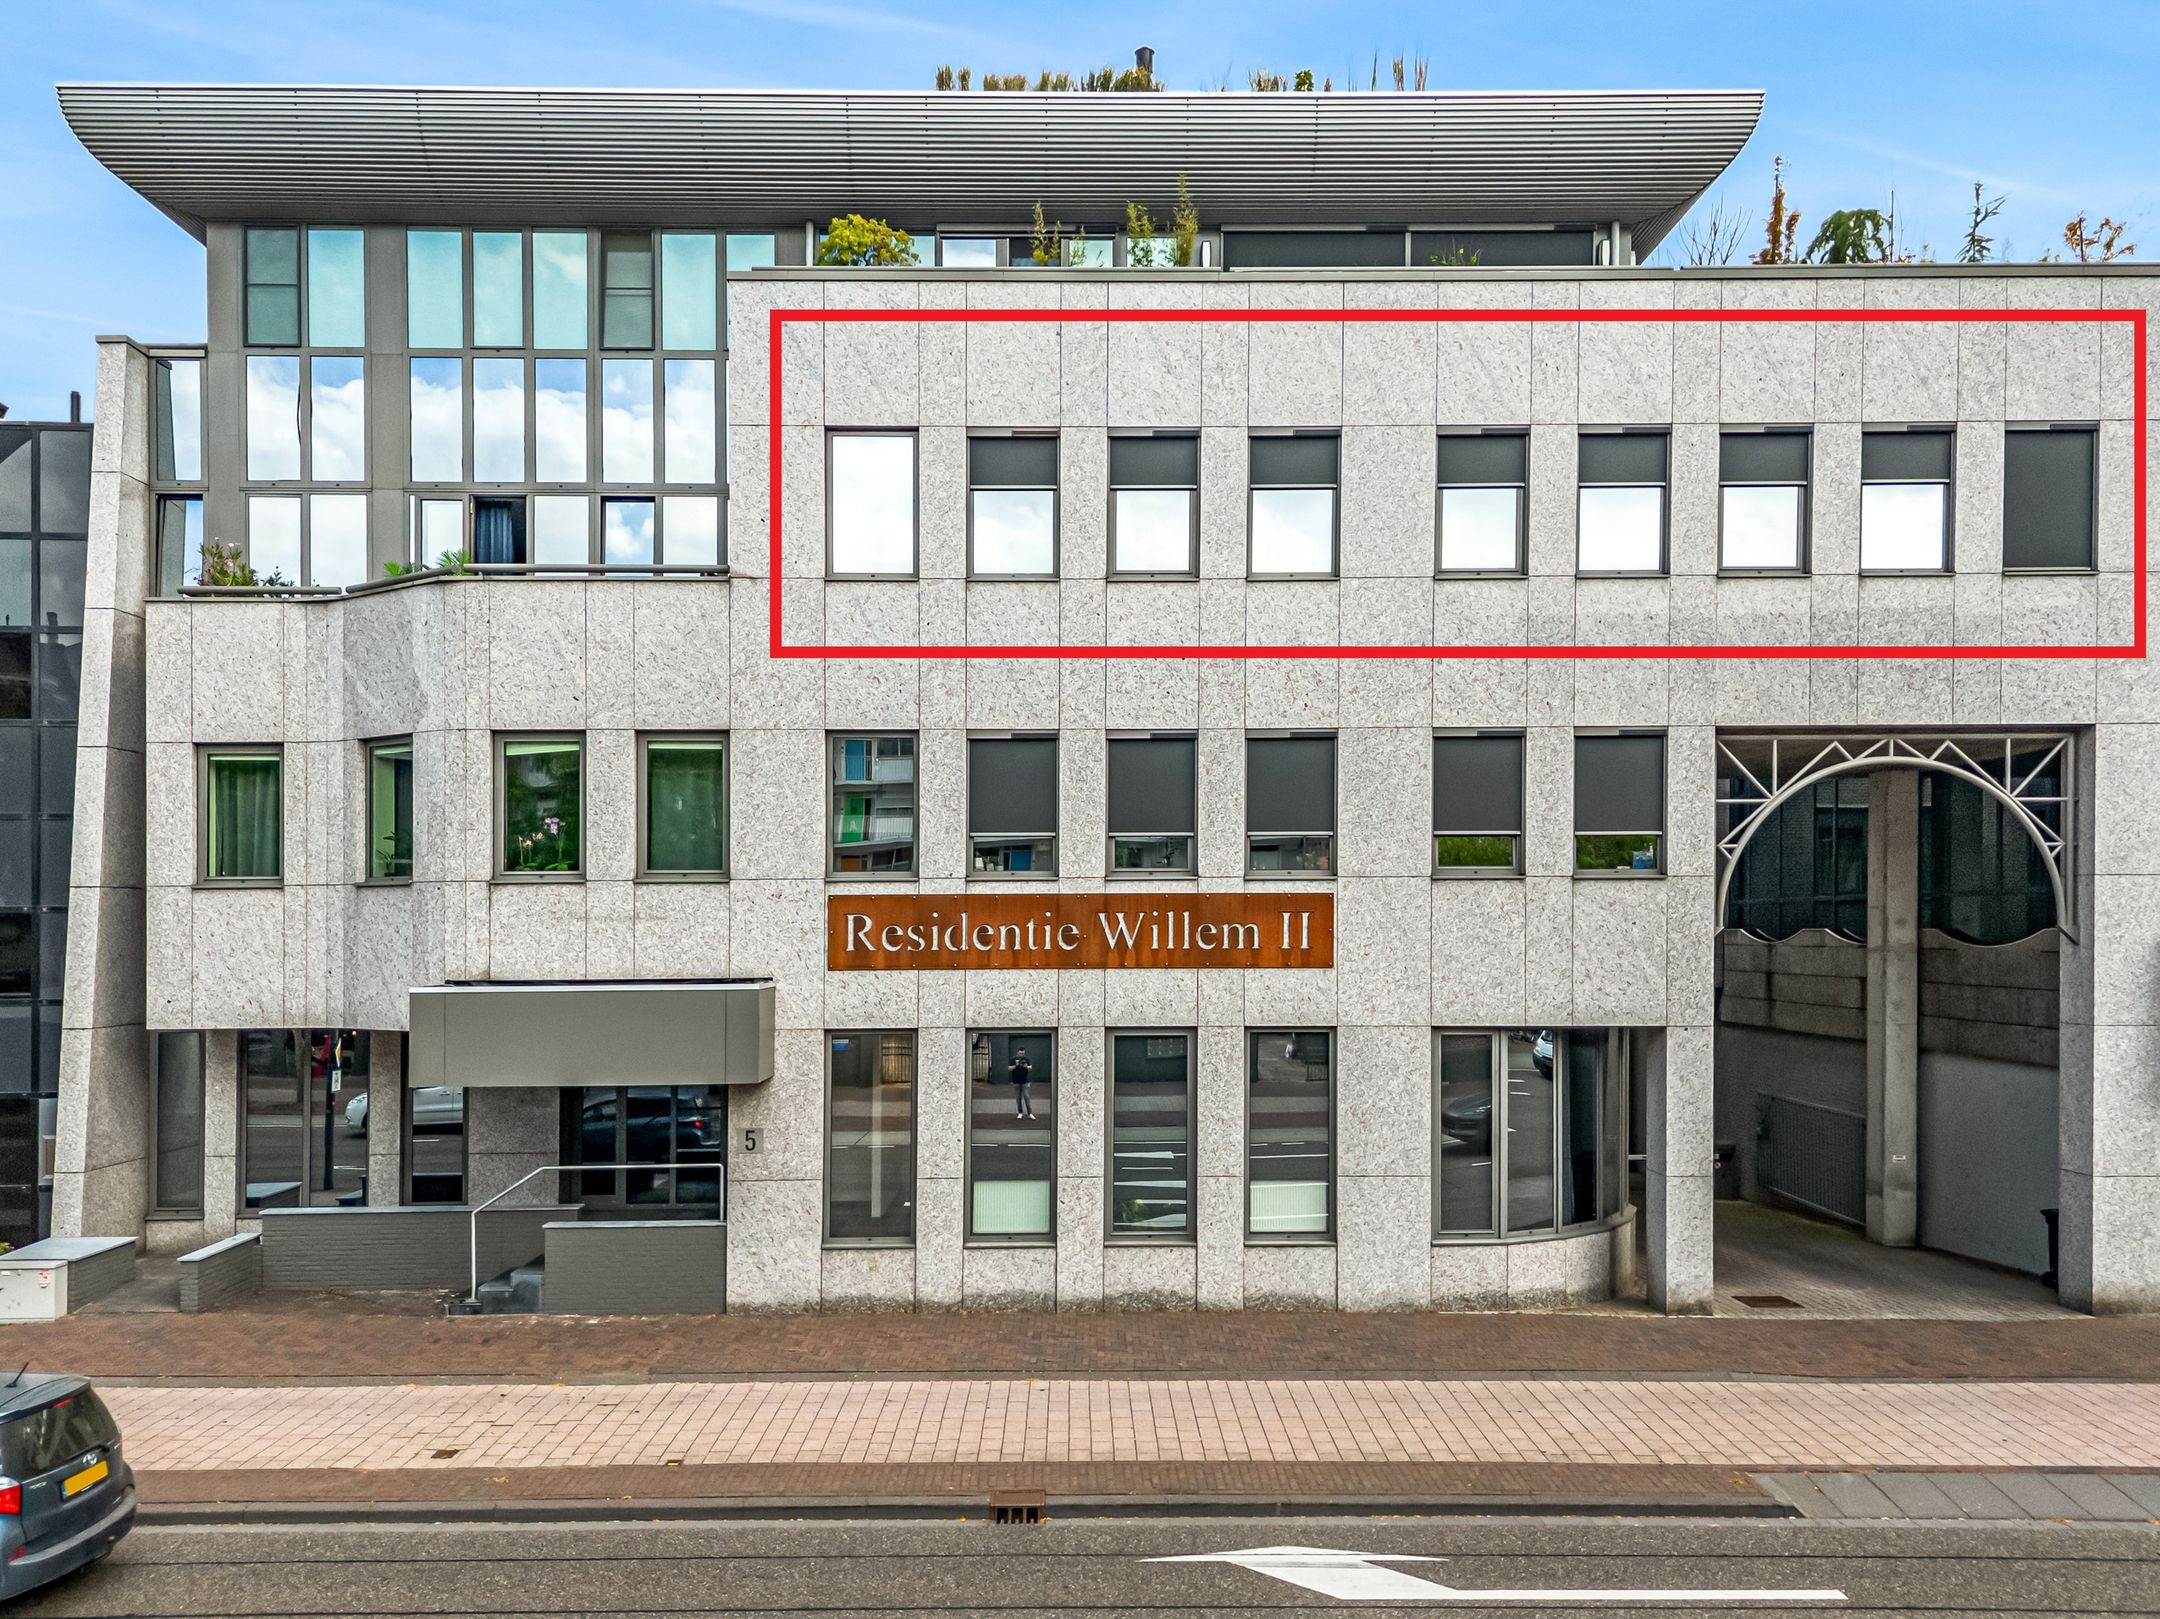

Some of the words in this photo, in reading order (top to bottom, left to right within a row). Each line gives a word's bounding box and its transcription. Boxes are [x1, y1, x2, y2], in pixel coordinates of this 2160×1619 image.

[844, 911, 1080, 952] Residentie
[1096, 910, 1262, 950] Willem
[1279, 911, 1312, 950] II
[745, 1130, 756, 1151] 5
